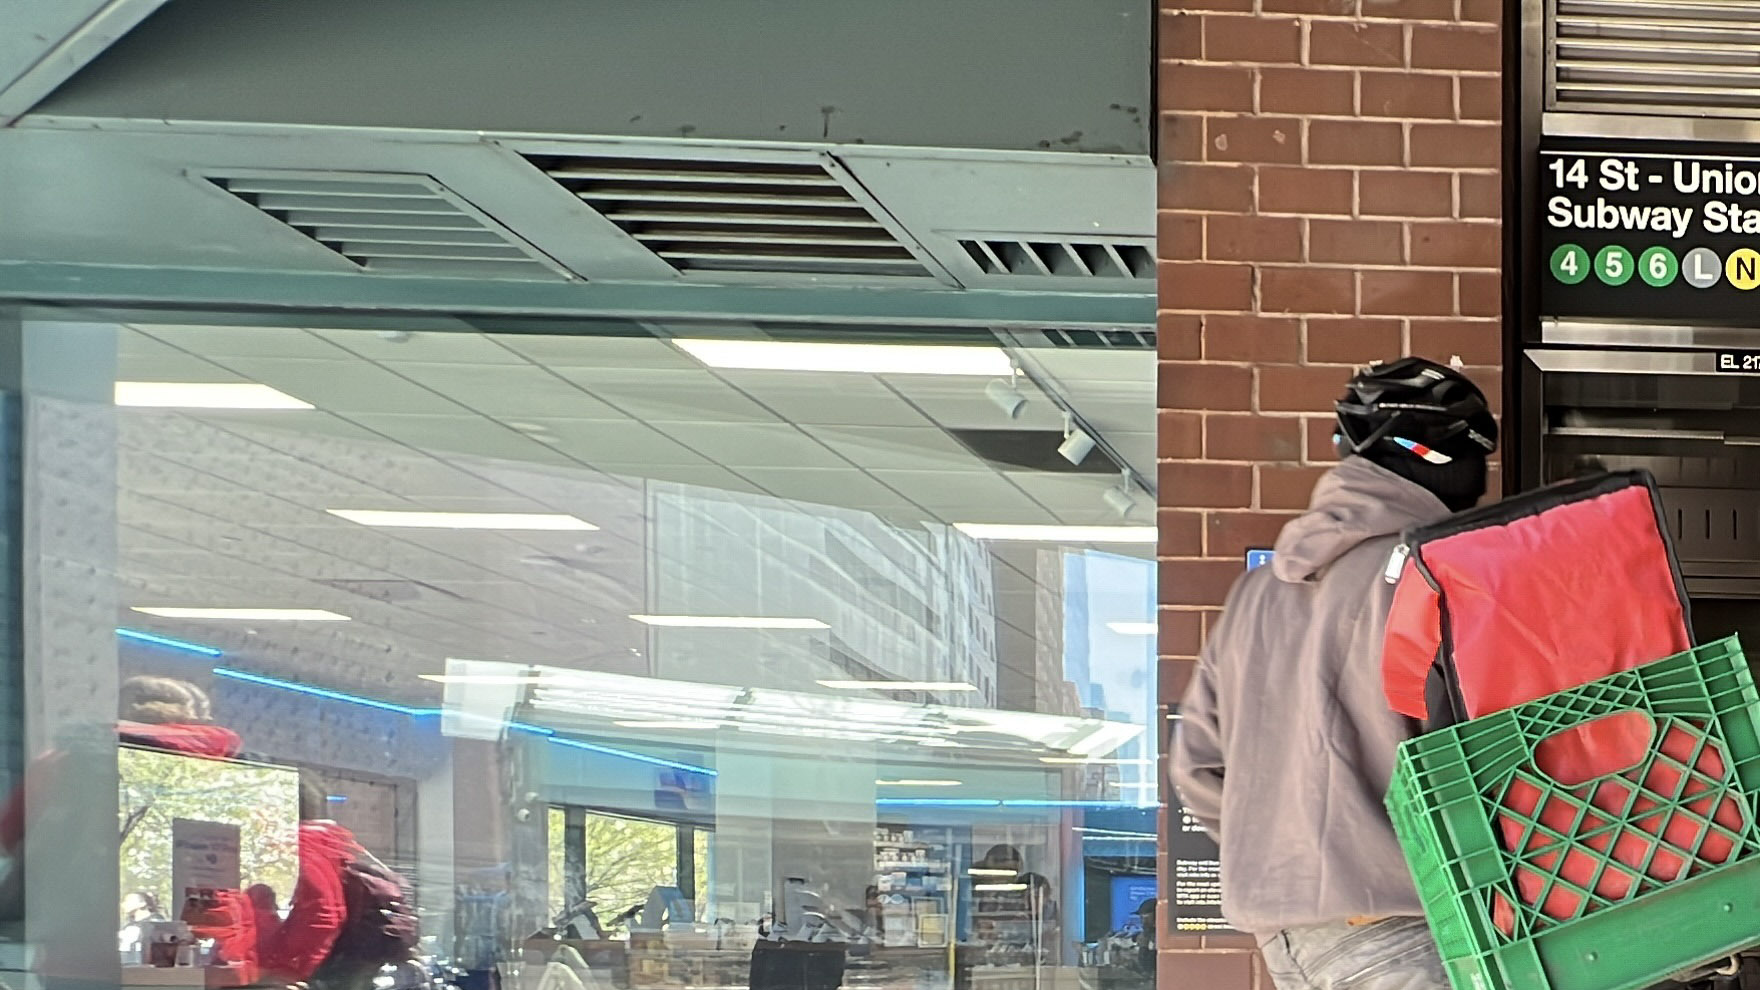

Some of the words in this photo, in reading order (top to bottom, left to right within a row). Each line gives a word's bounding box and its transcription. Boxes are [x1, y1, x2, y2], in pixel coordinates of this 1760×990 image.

[1548, 157, 1590, 190] 14
[1598, 158, 1640, 192] St
[1647, 174, 1664, 184] -
[1547, 195, 1694, 239] Subway
[1720, 353, 1740, 369] EL
